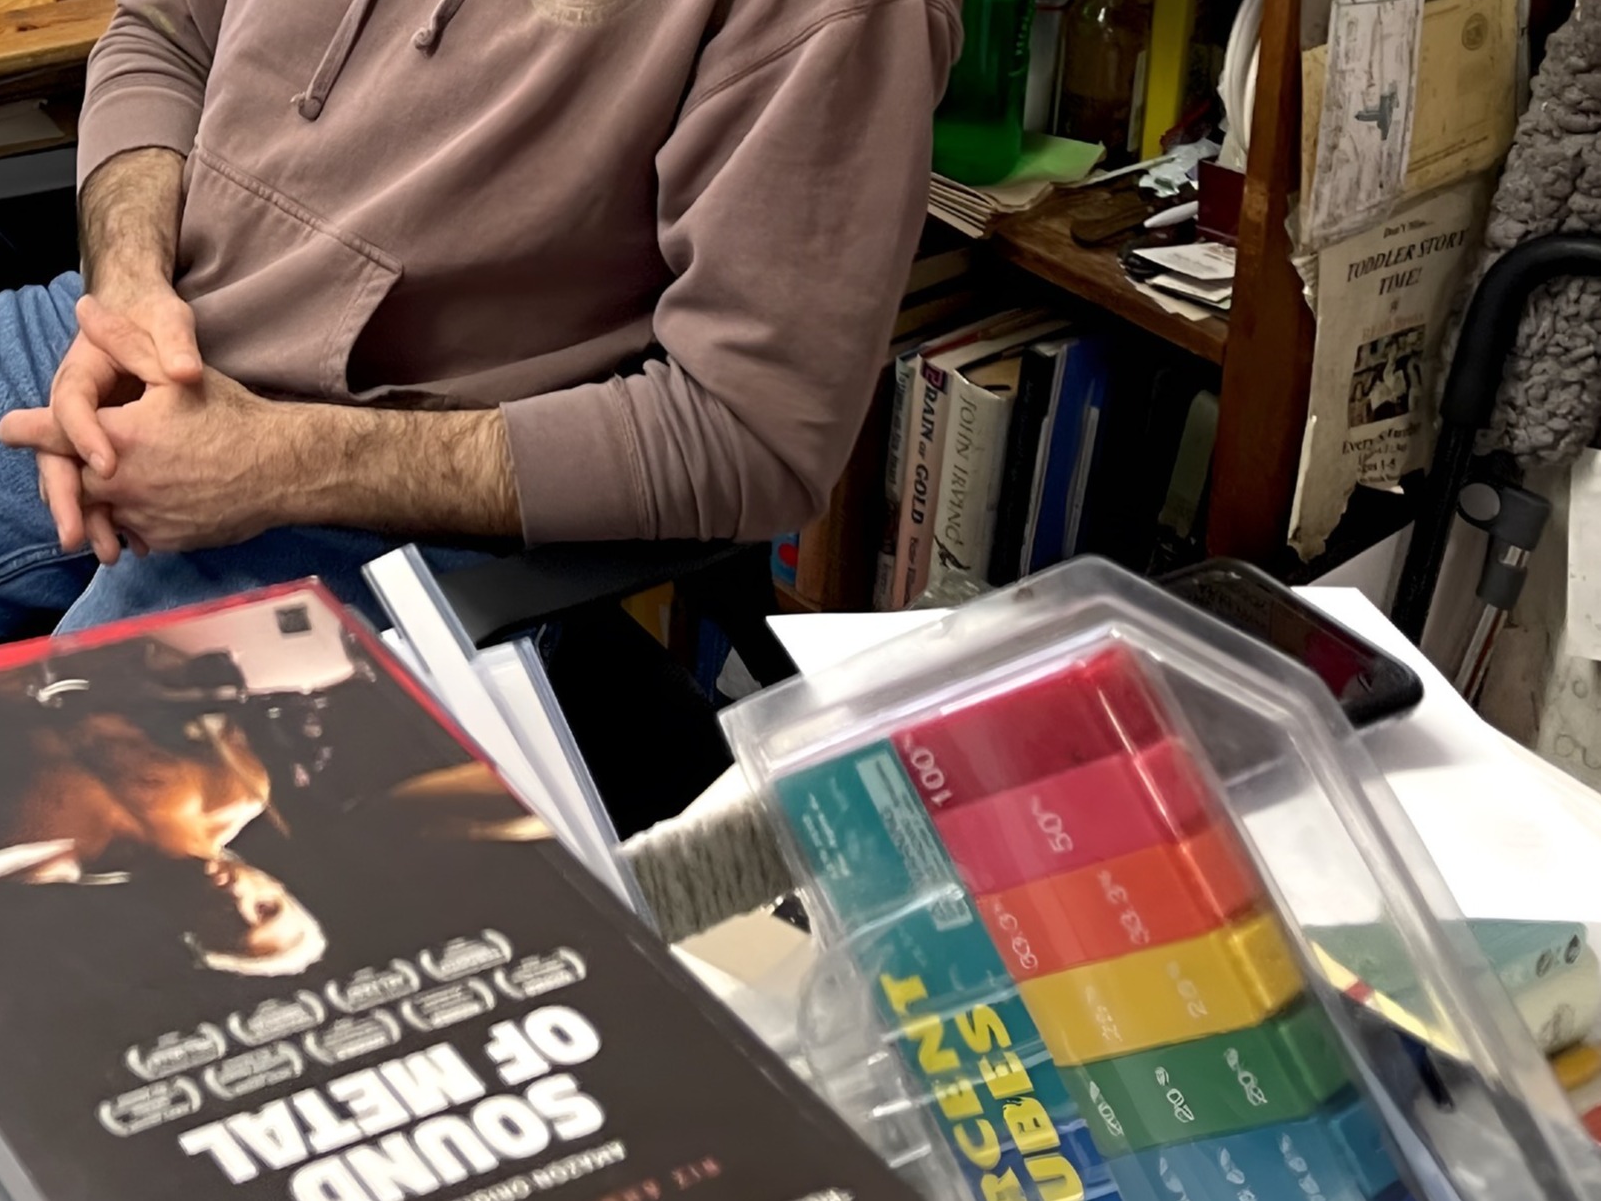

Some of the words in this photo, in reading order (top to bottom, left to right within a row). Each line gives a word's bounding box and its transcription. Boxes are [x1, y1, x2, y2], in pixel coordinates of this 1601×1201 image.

[1347, 242, 1417, 283] TODDLER
[1417, 228, 1469, 261] STORY
[1378, 267, 1424, 296] TIME!
[920, 385, 938, 443] RAIN
[956, 394, 978, 461] JOHN
[910, 463, 930, 526] GOLD
[944, 463, 969, 547] IRVING
[486, 1005, 601, 1086] OF
[179, 1042, 487, 1185] METAL
[290, 1072, 605, 1201] SOUND
[531, 1138, 628, 1189] AMAZON
